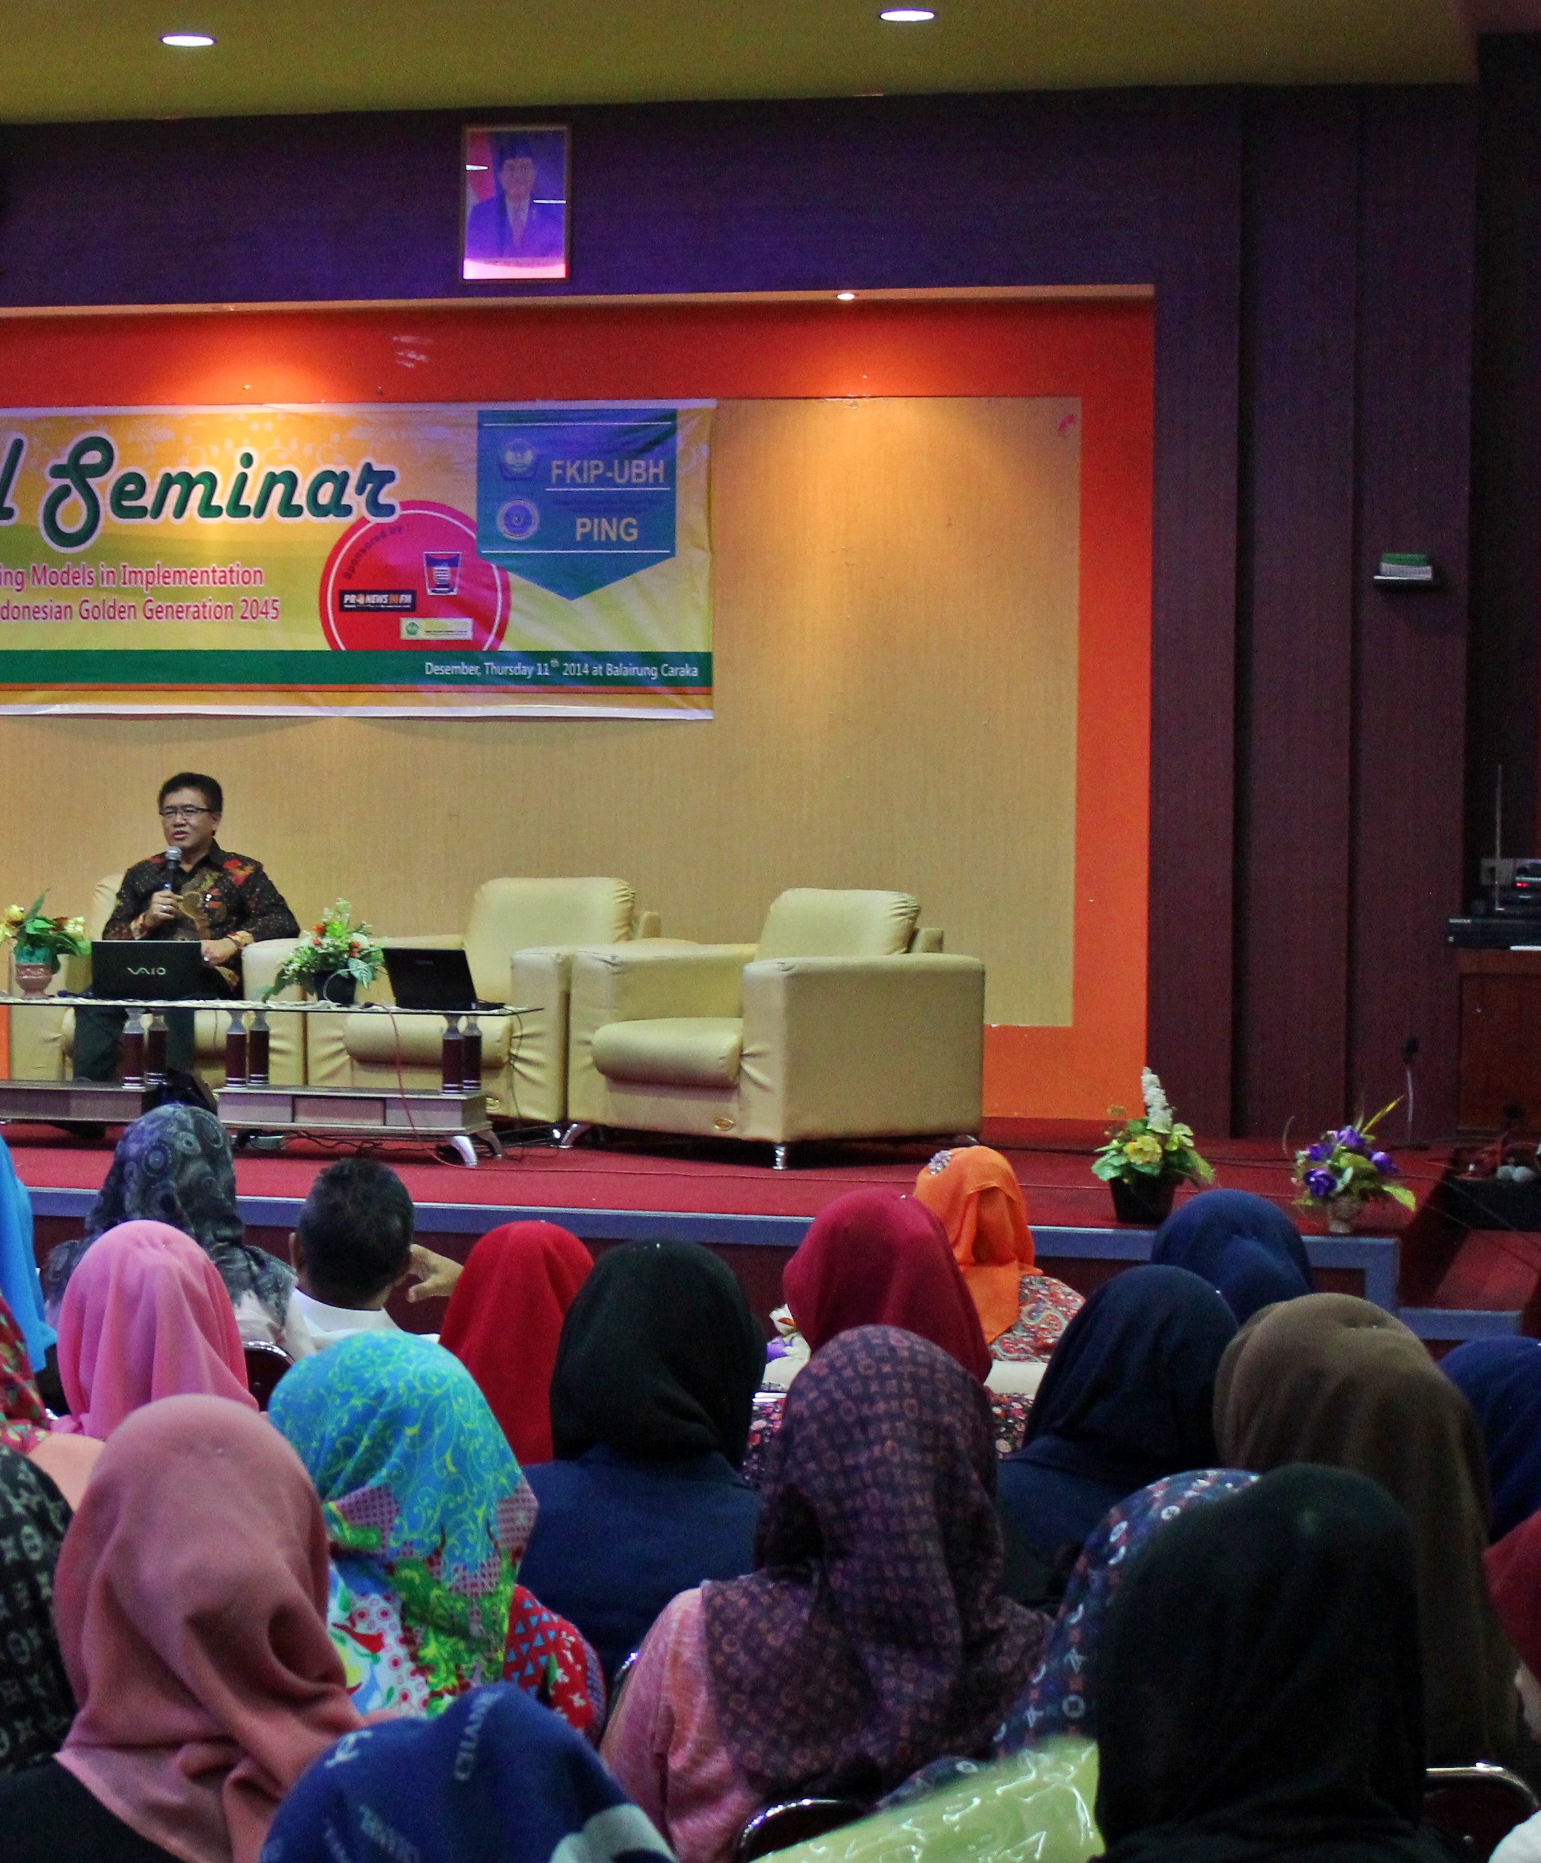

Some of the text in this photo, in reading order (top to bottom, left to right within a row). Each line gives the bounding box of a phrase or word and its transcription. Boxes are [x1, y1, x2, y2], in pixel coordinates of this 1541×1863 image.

[551, 460, 665, 483] FKIP-UBH
[43, 436, 396, 548] Seminar
[575, 518, 639, 542] PING
[343, 525, 403, 580] Sponsored by
[31, 563, 95, 586] Models
[100, 563, 117, 586] in
[121, 562, 264, 592] Implementation
[78, 598, 137, 621] Golden
[143, 598, 234, 621] Generation
[239, 598, 280, 621] 2045
[425, 662, 481, 677] Desember,
[484, 662, 534, 679] Thursday
[562, 663, 590, 676] 2014
[592, 664, 604, 676] at
[606, 663, 658, 680] Balairung
[660, 664, 699, 677] Caraka
[127, 967, 166, 975] VAIO
